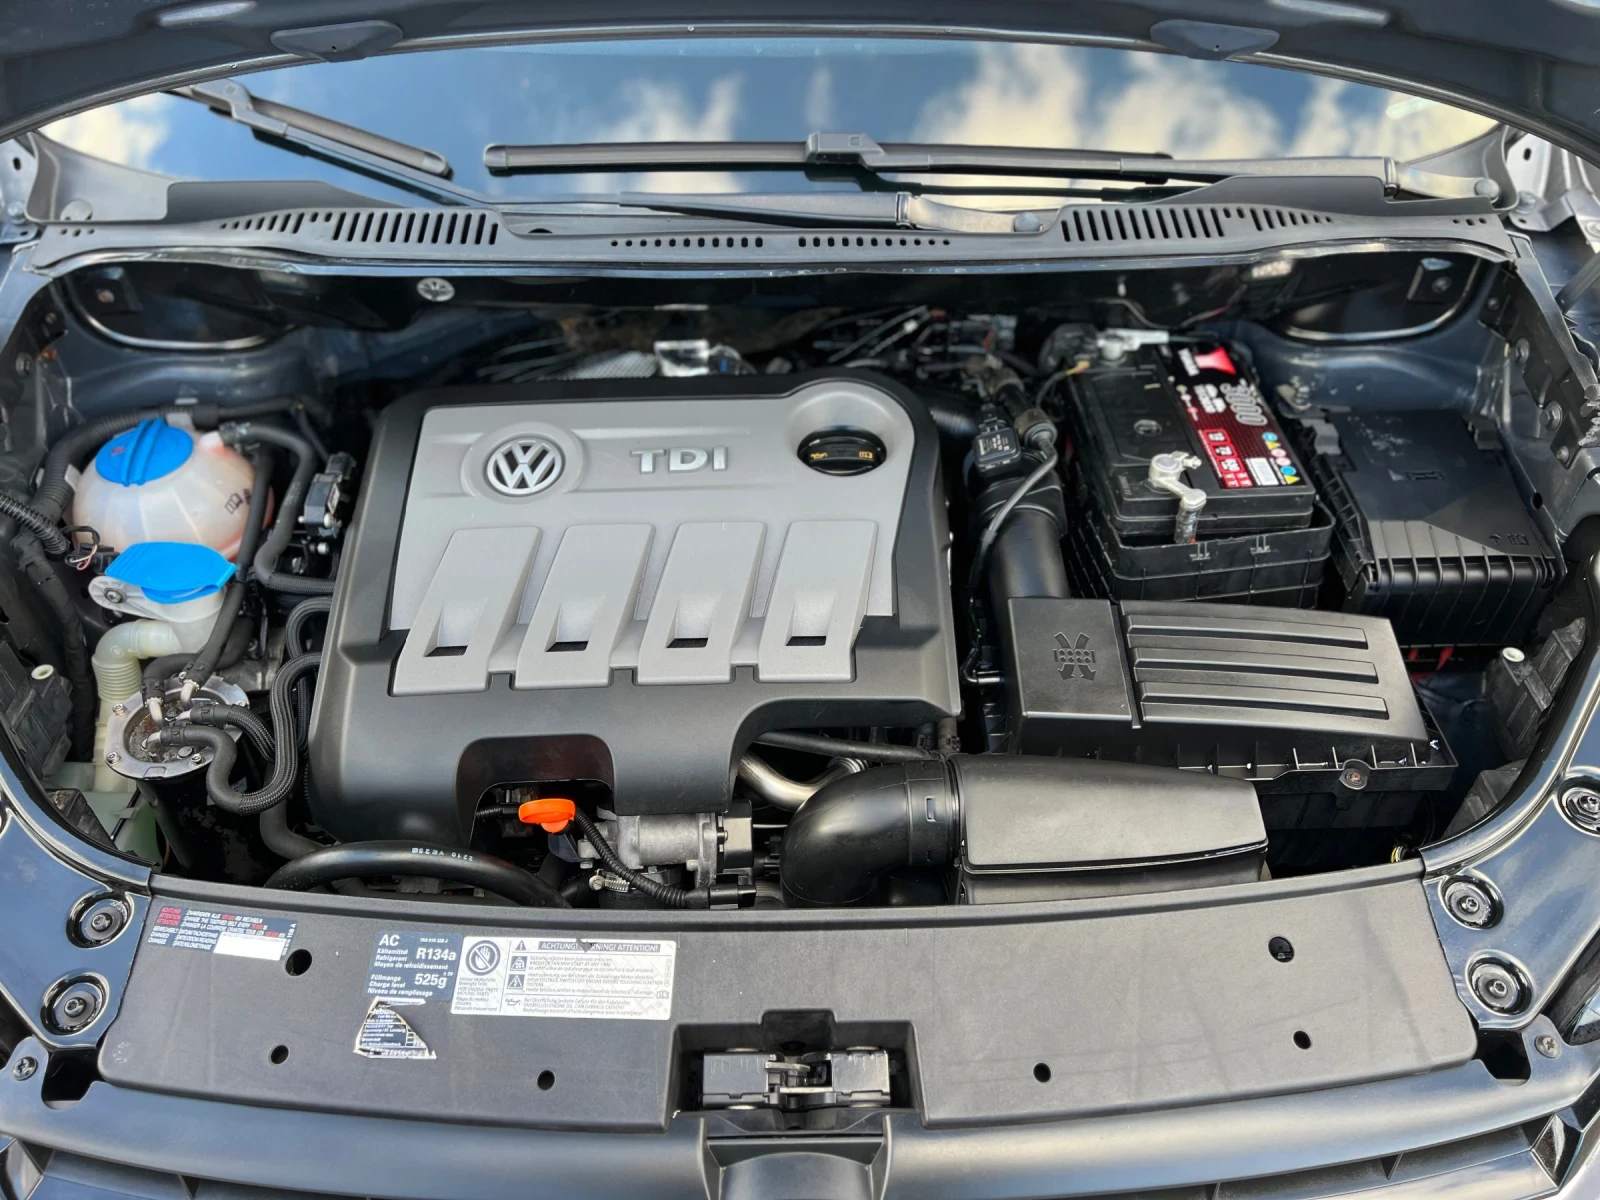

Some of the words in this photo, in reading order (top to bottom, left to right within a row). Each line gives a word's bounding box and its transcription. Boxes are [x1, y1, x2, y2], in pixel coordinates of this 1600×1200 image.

[631, 447, 728, 474] TDI
[379, 934, 400, 947] AC
[542, 942, 578, 950] ACHTUNG!
[617, 944, 658, 952] ATTENTION!
[415, 947, 457, 961] R134a
[414, 973, 447, 989] 525g
[398, 989, 433, 997] remplissage
